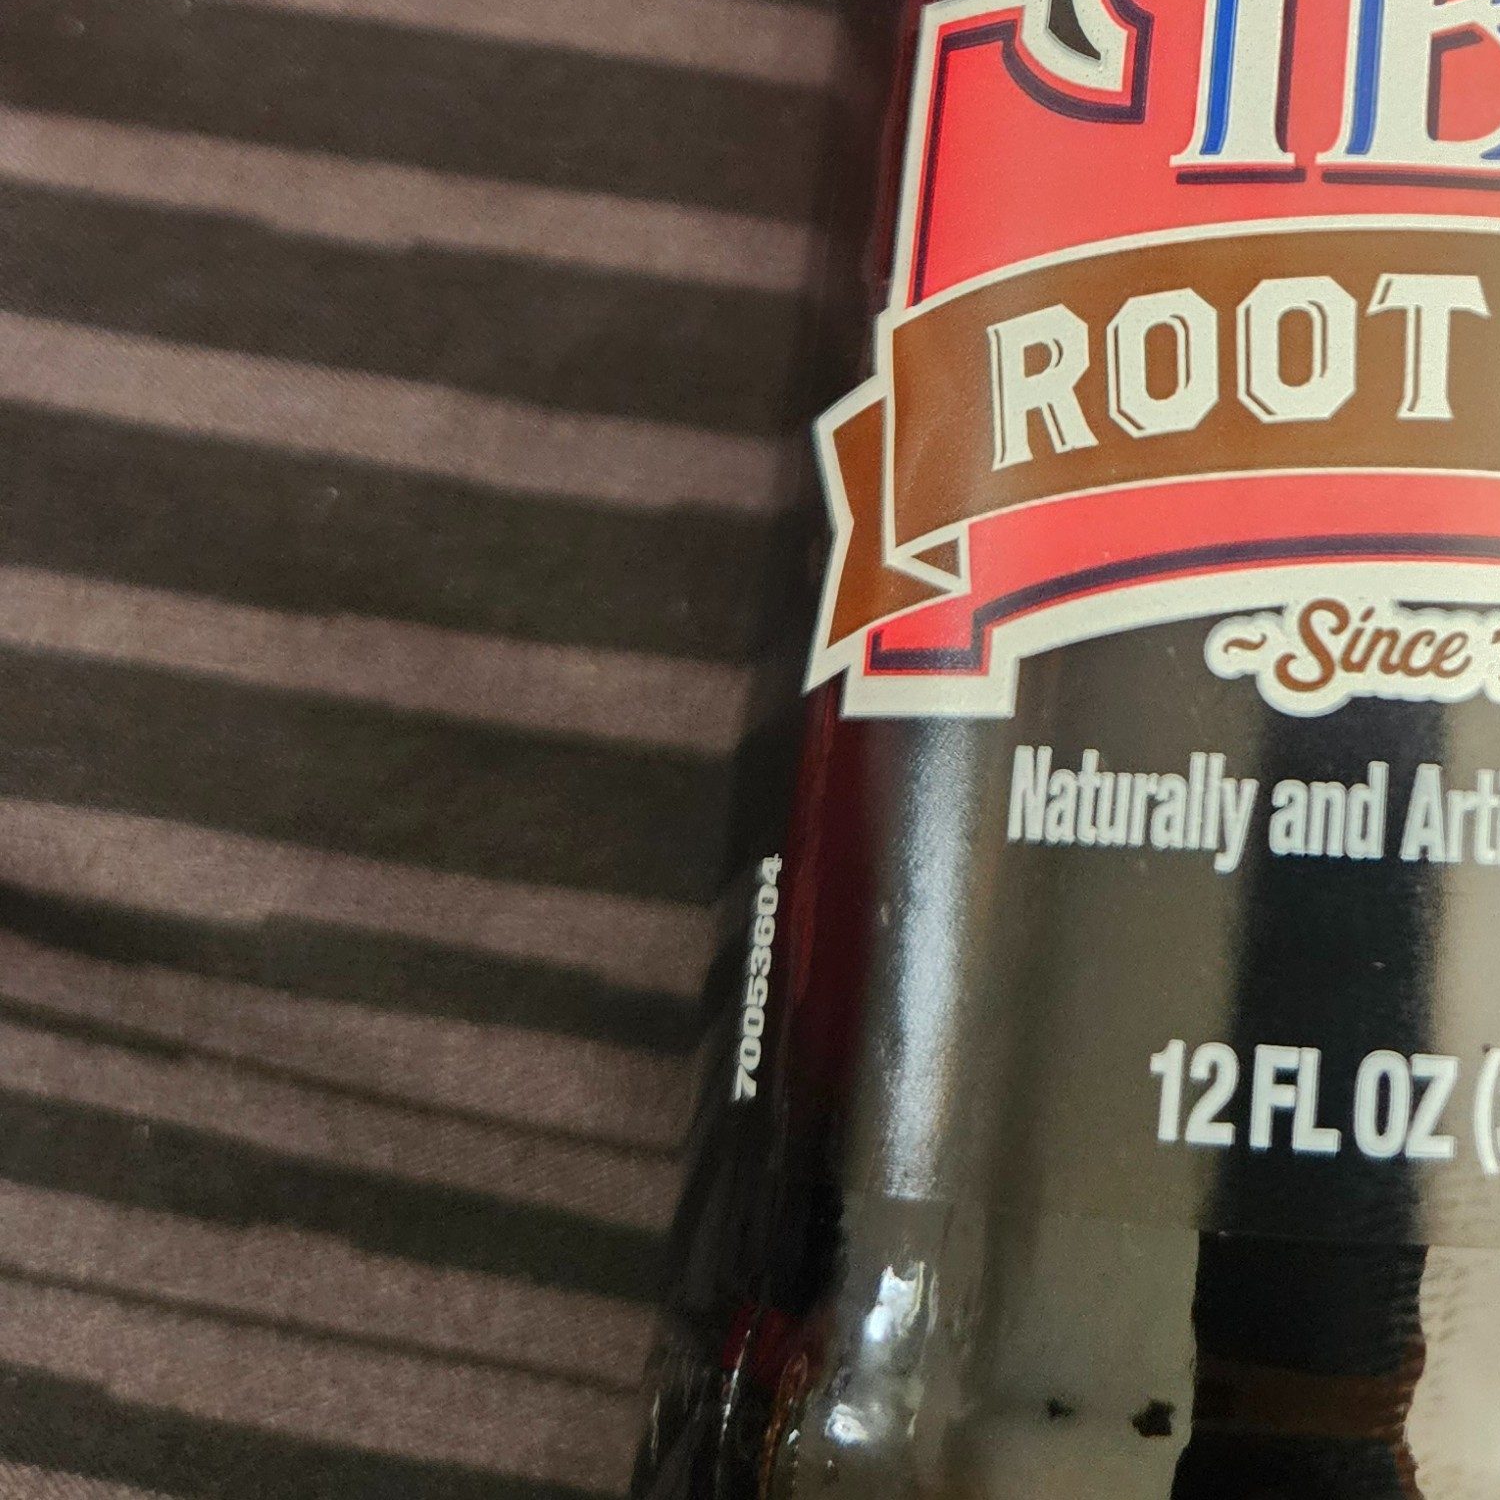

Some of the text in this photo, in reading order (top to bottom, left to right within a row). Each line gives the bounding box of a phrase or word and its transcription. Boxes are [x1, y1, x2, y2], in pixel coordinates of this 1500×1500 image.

[986, 272, 1492, 472] ROOT
[1273, 597, 1473, 694] Since
[1007, 744, 1261, 875] Naturally
[1267, 760, 1391, 861] and
[734, 852, 783, 1102] 70053604
[1149, 1037, 1240, 1146] 12
[1249, 1043, 1342, 1155] FL
[1353, 1049, 1460, 1160] OZ
